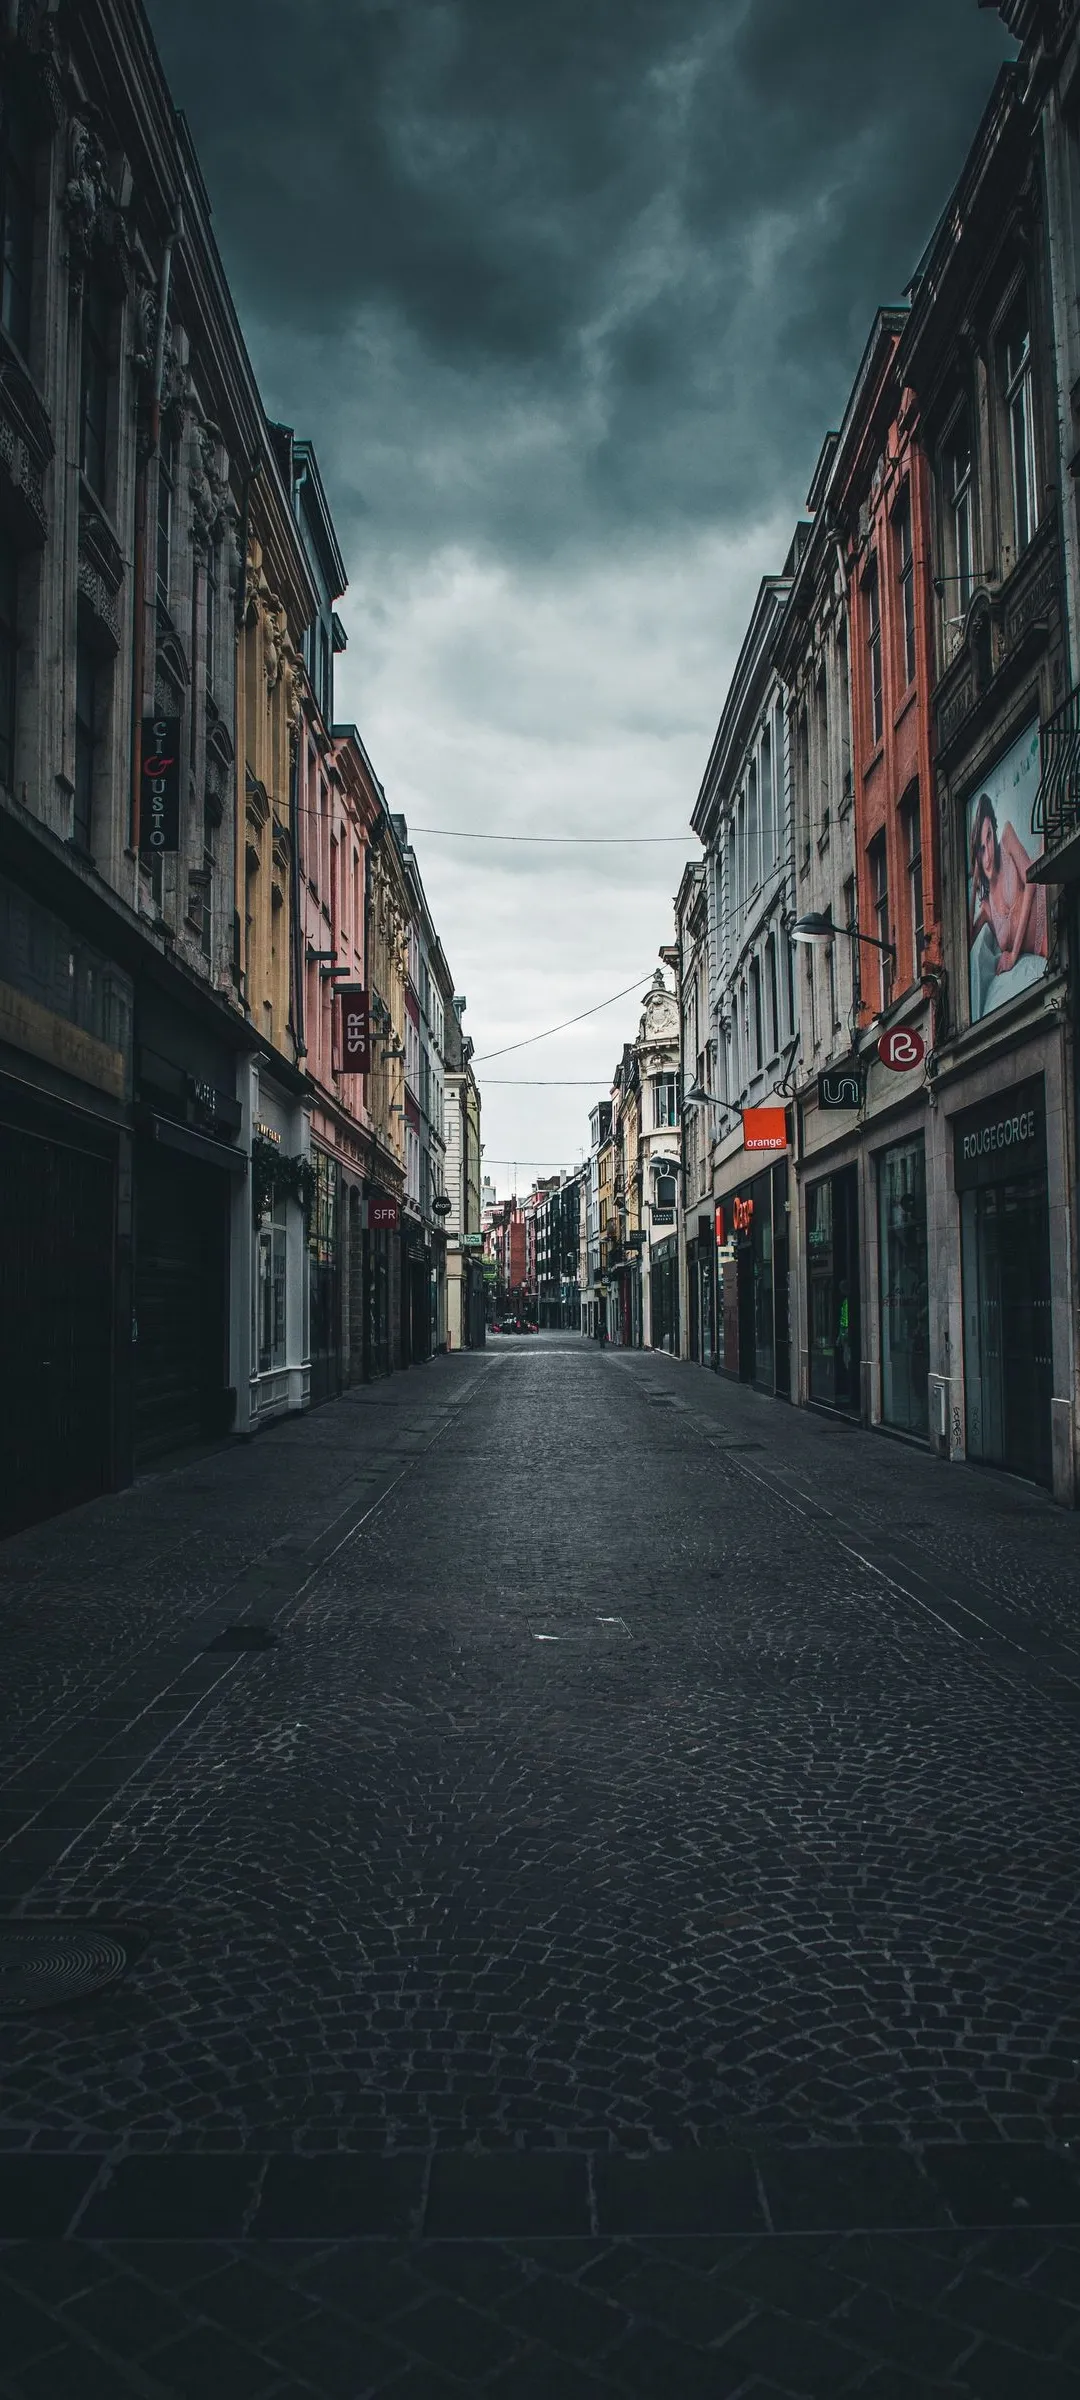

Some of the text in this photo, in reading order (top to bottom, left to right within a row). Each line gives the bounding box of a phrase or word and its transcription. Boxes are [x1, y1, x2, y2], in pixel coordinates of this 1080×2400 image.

[347, 1013, 365, 1053] SFR
[746, 1138, 782, 1148] orange
[963, 1110, 1035, 1160] ROUGEGORGE
[373, 1209, 396, 1220] SFR
